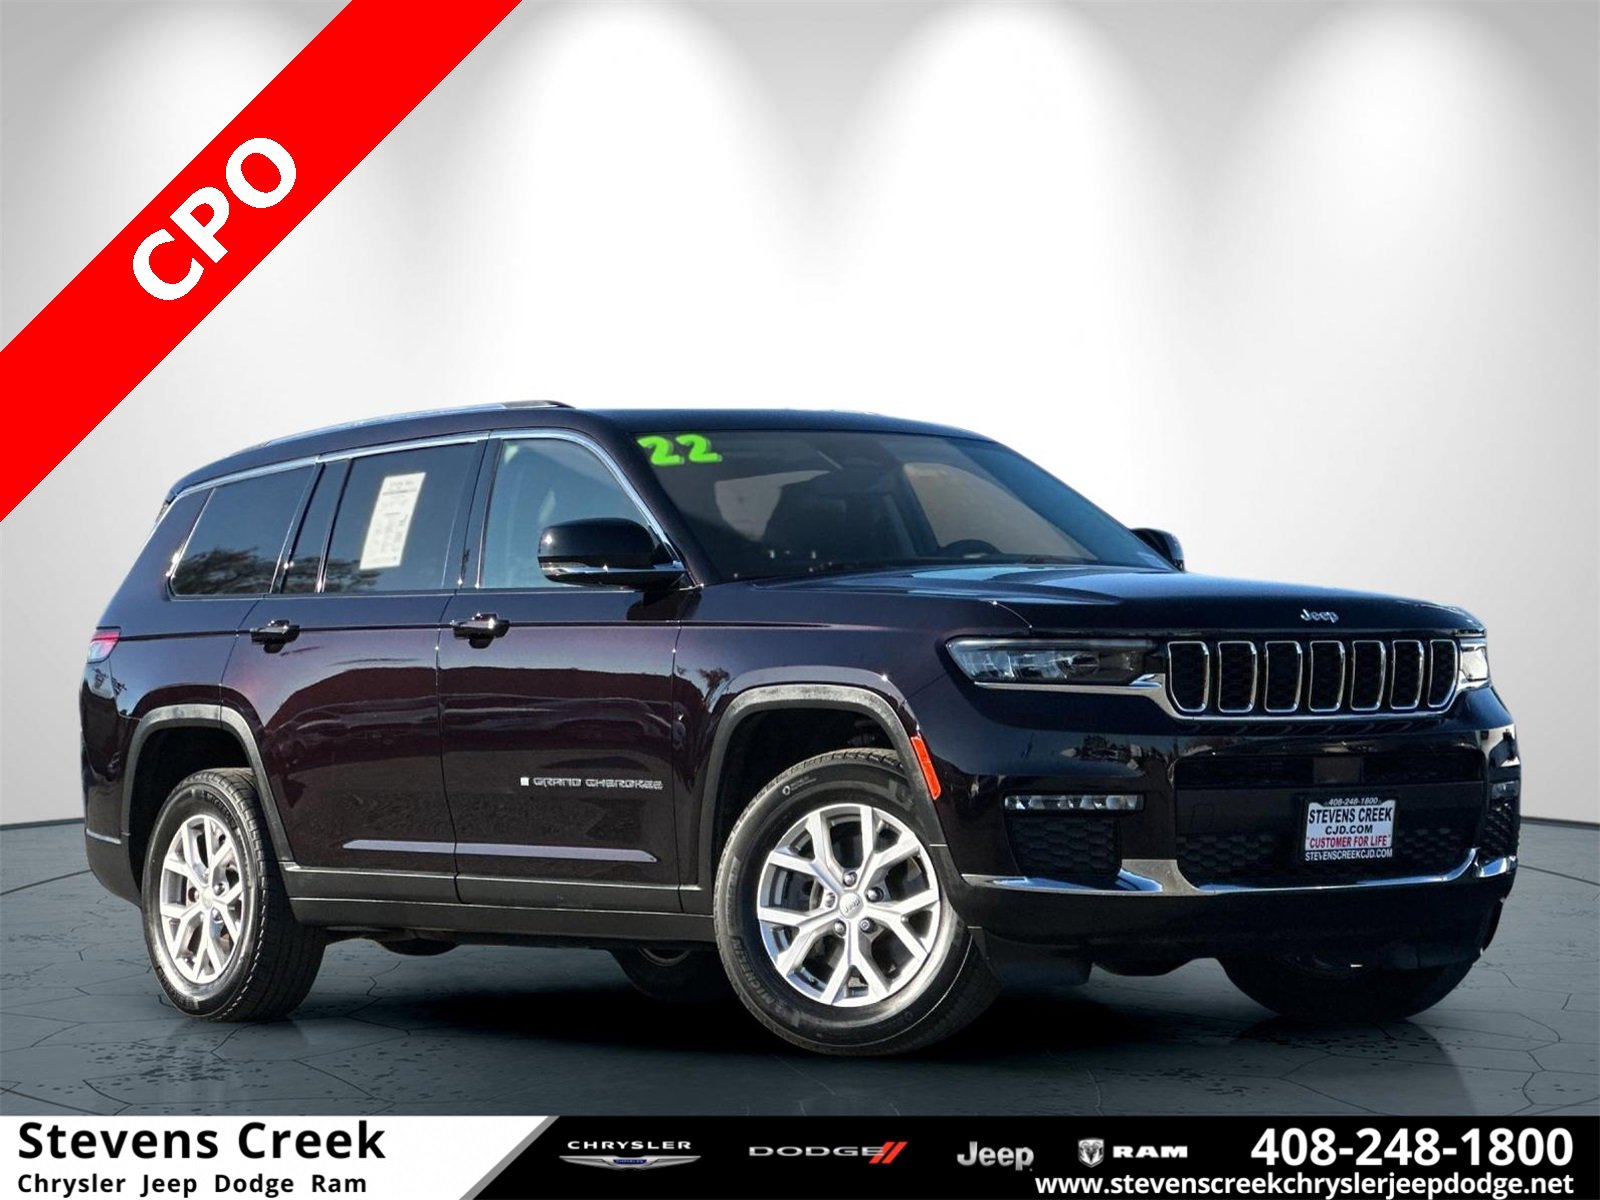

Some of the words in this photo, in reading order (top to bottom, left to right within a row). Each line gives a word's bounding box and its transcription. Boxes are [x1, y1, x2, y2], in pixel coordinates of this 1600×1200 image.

[637, 433, 723, 466] 22
[1300, 608, 1339, 624] Jeep
[533, 777, 582, 788] GRAND
[585, 778, 664, 790] CHEROKEE
[1328, 797, 1378, 806] 408-248-1800
[1308, 809, 1356, 823] STEVENS
[1358, 807, 1393, 823] CREEK
[1325, 825, 1373, 835] CJD.COM
[1353, 836, 1369, 848] FOR
[1305, 848, 1393, 861] STEVENSCREEKCJD.COM
